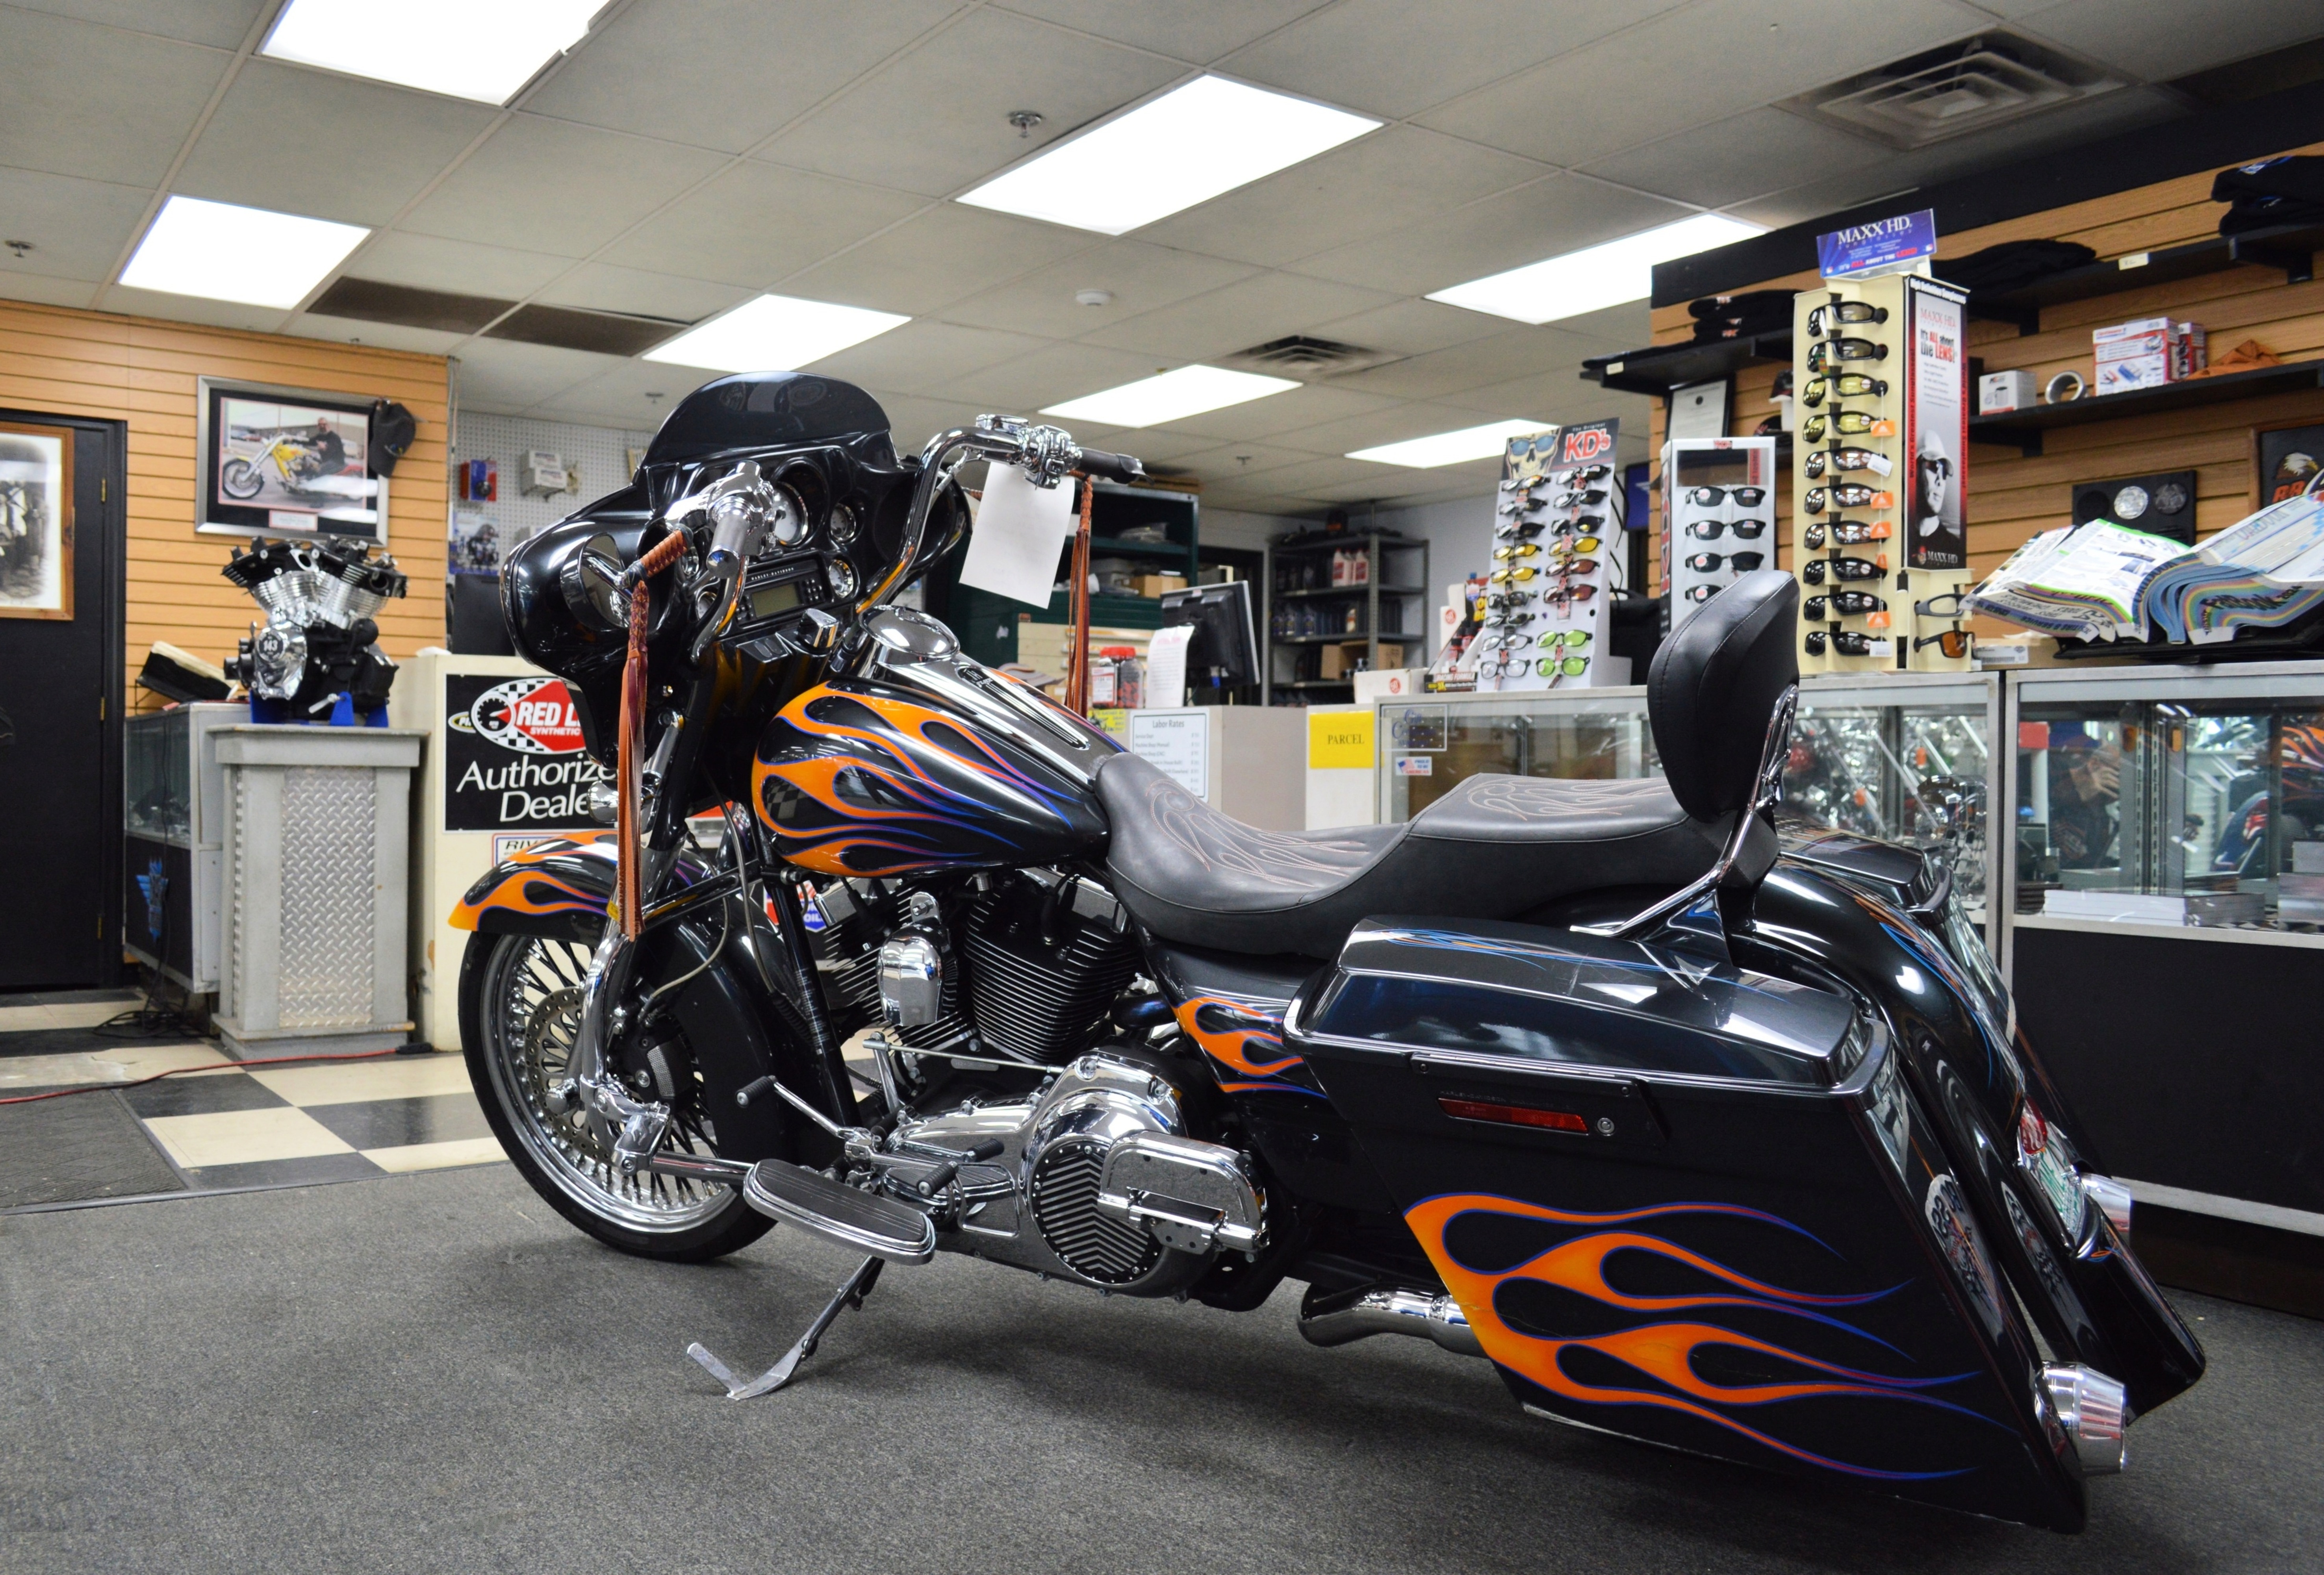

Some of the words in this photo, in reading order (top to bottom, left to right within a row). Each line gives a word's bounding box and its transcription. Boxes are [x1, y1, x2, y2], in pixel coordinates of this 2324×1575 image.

[1838, 221, 1884, 245] MAXX
[1920, 308, 1943, 324] MAXX
[1563, 428, 1611, 463] KD's
[1927, 550, 1947, 562] MAXX
[751, 567, 794, 581] HARLEY-DAVIDSON
[263, 639, 278, 652] 143
[516, 702, 561, 726] RED
[1152, 719, 1168, 728] Labor
[1169, 719, 1185, 728] Rates
[530, 727, 581, 736] SYNTHETIC
[1328, 734, 1365, 745] PARCEL
[456, 752, 617, 793] Authorize
[500, 784, 589, 822] Deale
